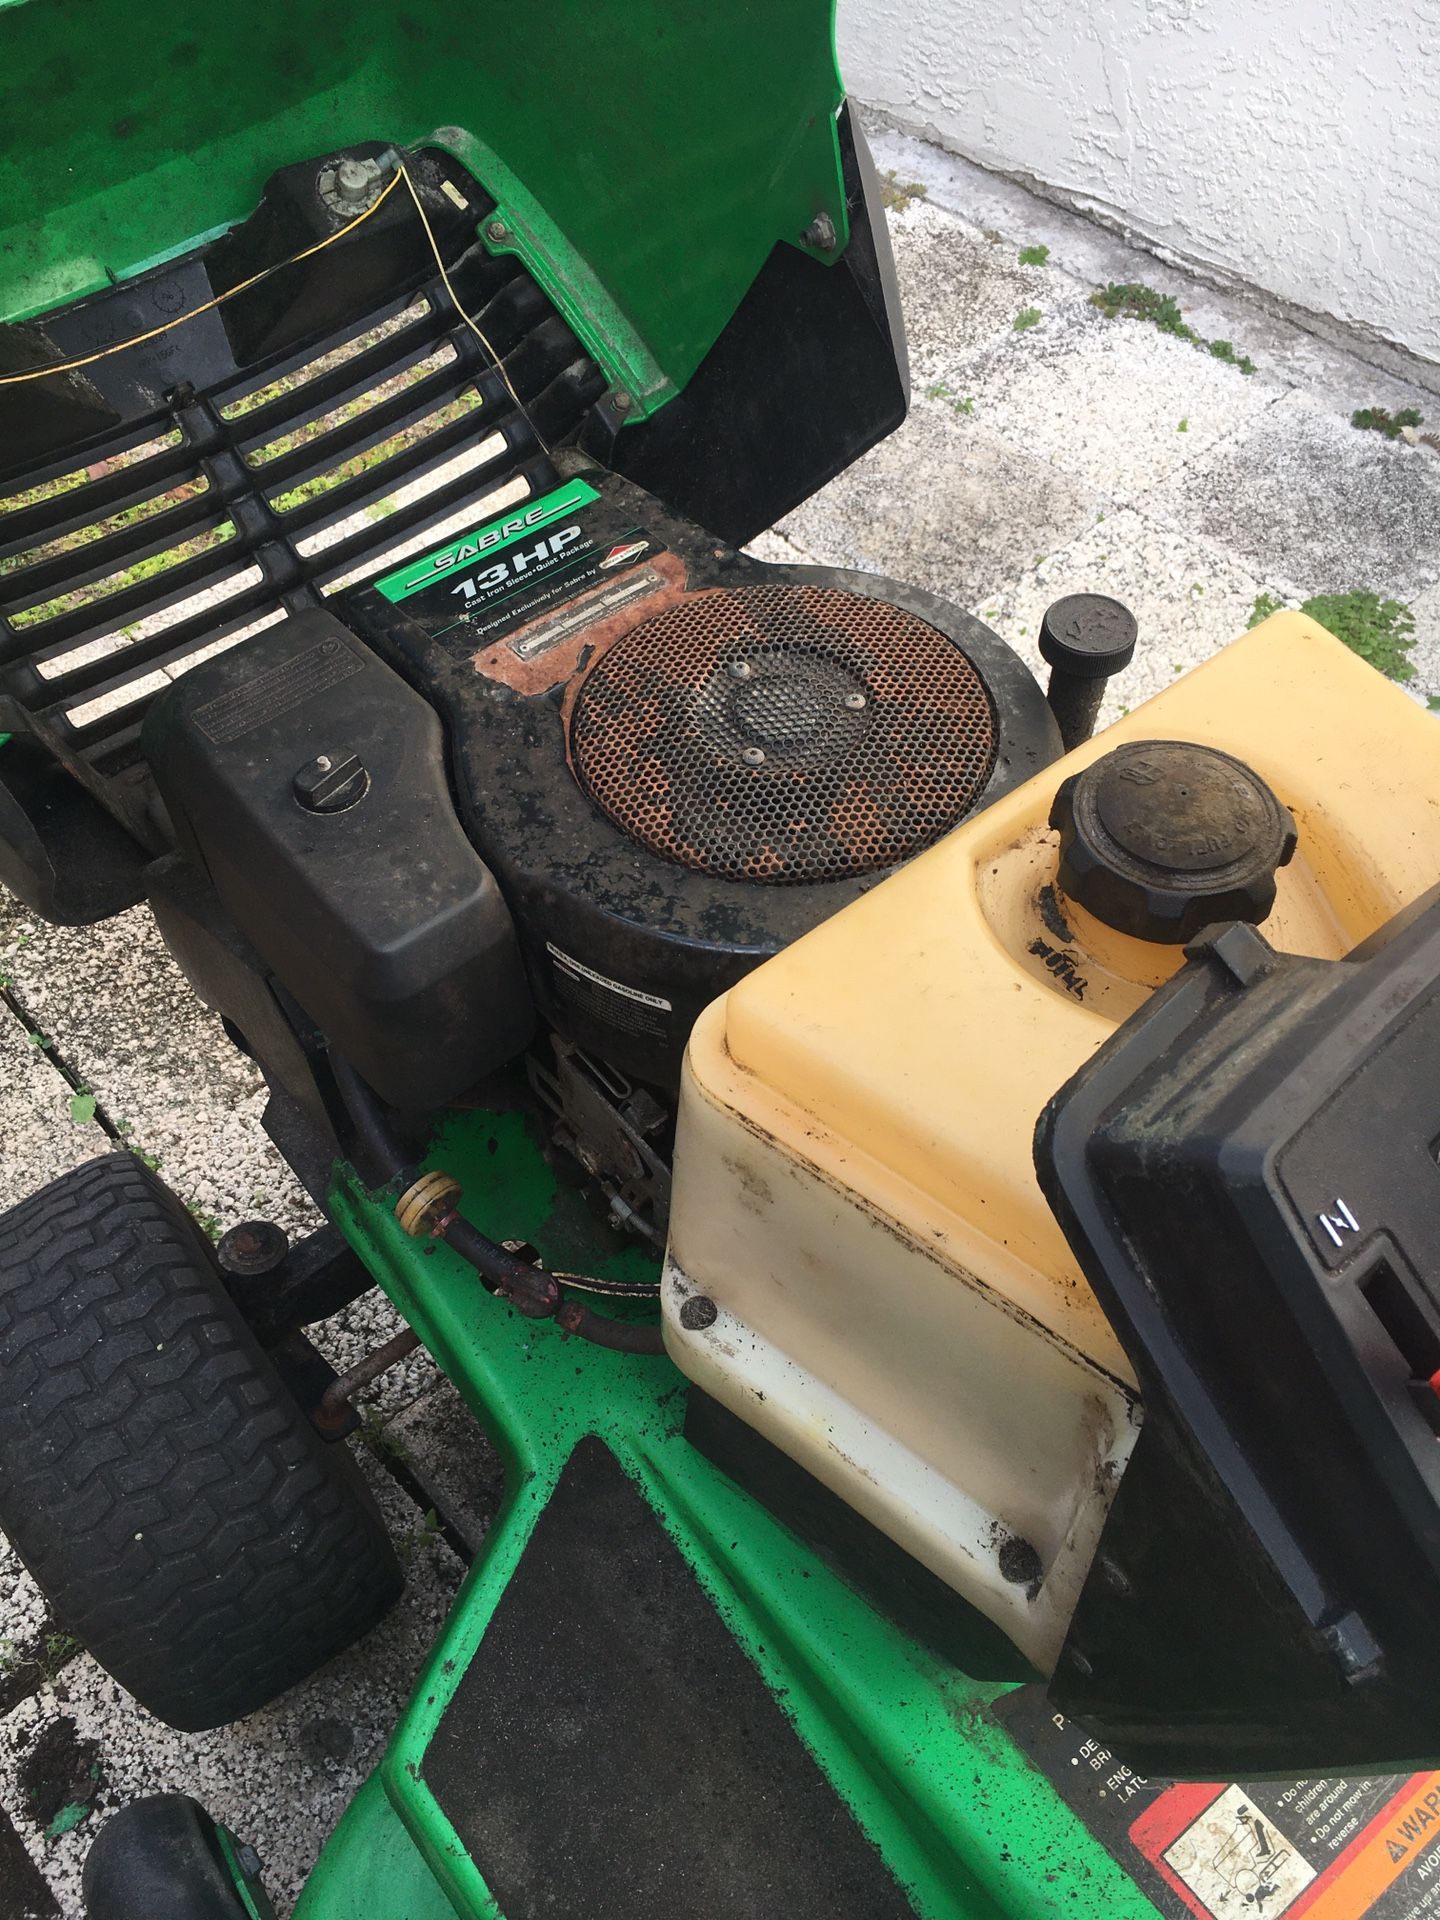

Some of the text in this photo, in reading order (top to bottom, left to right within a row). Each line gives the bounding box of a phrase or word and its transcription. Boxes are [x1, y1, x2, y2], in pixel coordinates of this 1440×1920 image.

[434, 506, 544, 569] SABRE
[450, 562, 510, 599] 13
[512, 525, 582, 573] HP
[464, 595, 486, 609] Cast
[486, 586, 505, 598] Iron
[560, 538, 594, 560] Package
[476, 568, 596, 635] Designed Exclusively for Sabre by
[1079, 1738, 1100, 1759] DE
[1282, 1788, 1297, 1802] Do
[1295, 1779, 1328, 1813] children
[1306, 1779, 1348, 1826] are around
[1315, 1780, 1372, 1839] Do not mow in
[1396, 1785, 1440, 1842] WAR
[1327, 1817, 1359, 1850] reverse
